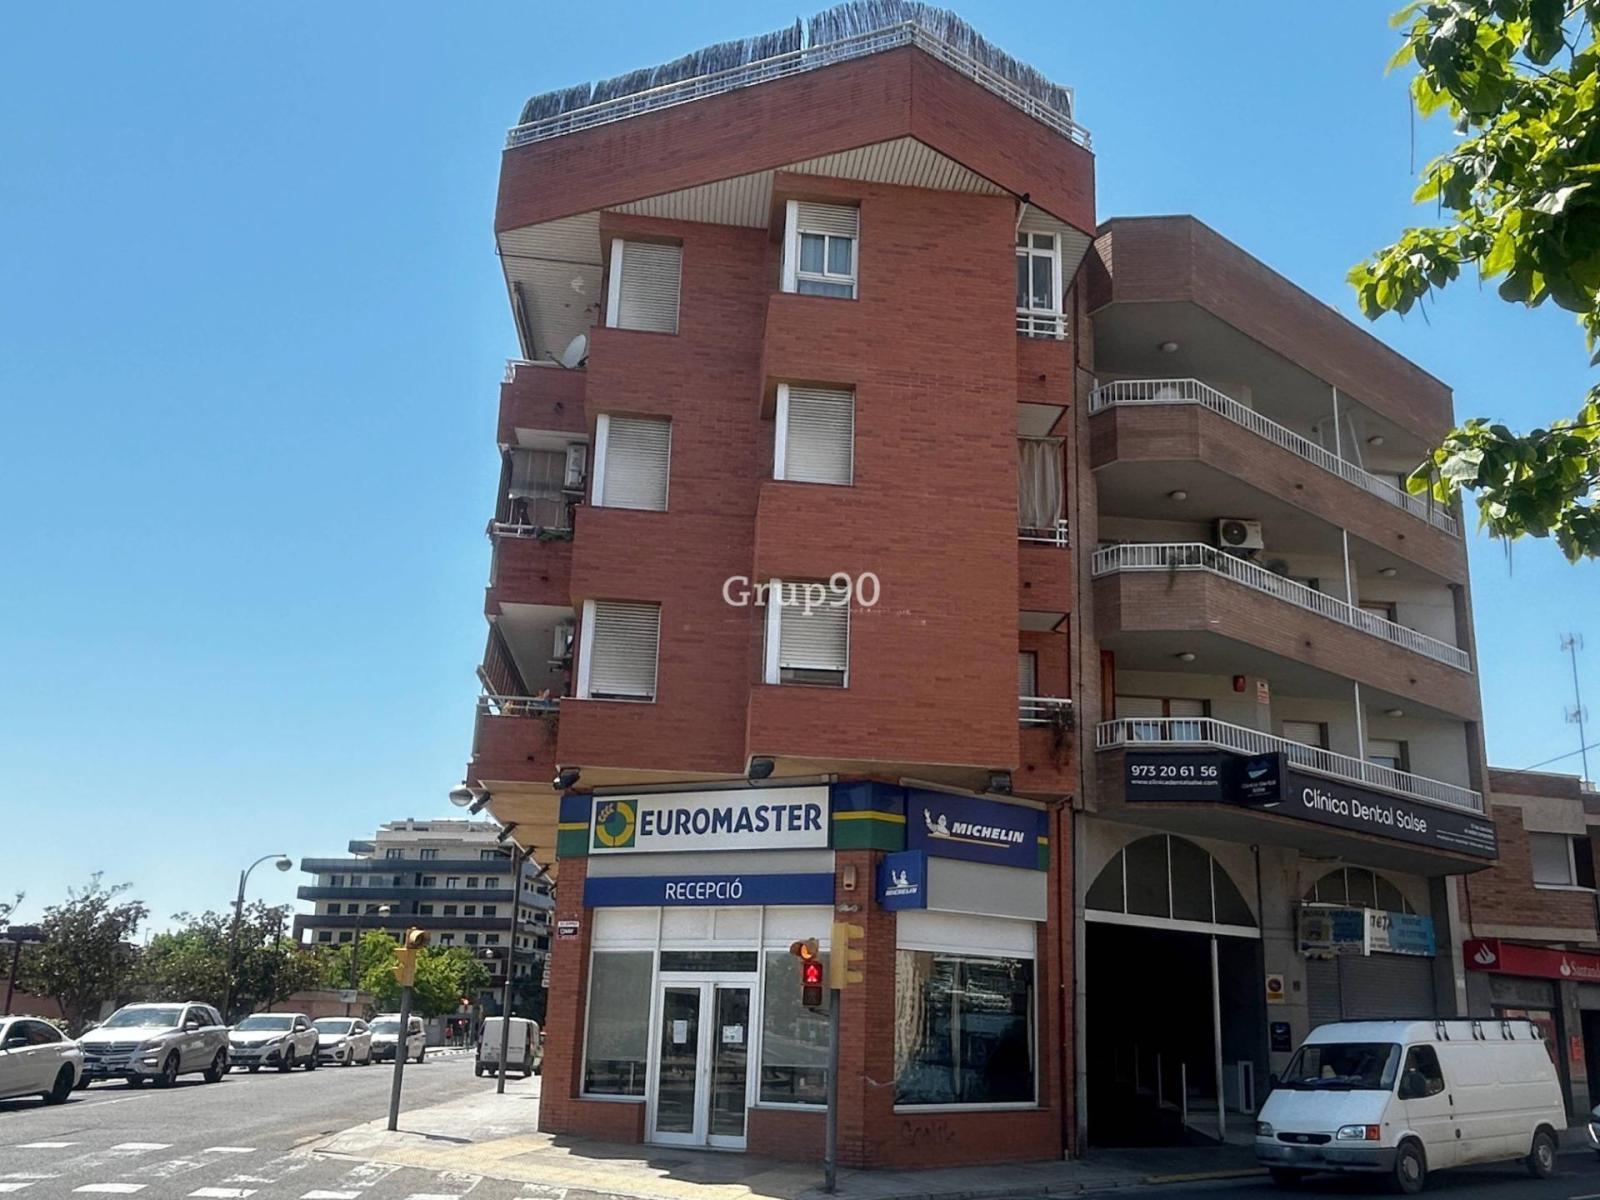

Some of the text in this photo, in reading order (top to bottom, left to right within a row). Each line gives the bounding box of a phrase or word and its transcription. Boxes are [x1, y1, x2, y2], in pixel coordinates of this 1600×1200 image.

[1131, 765, 1217, 777] 973 20 61 56
[640, 803, 822, 836] EUROMASTER
[1351, 799, 1394, 826] Dental
[1396, 809, 1427, 833] Salse
[951, 822, 1025, 843] MICHELIN
[665, 878, 743, 900] RECEPCIÓ
[885, 887, 918, 897] MICHELIN
